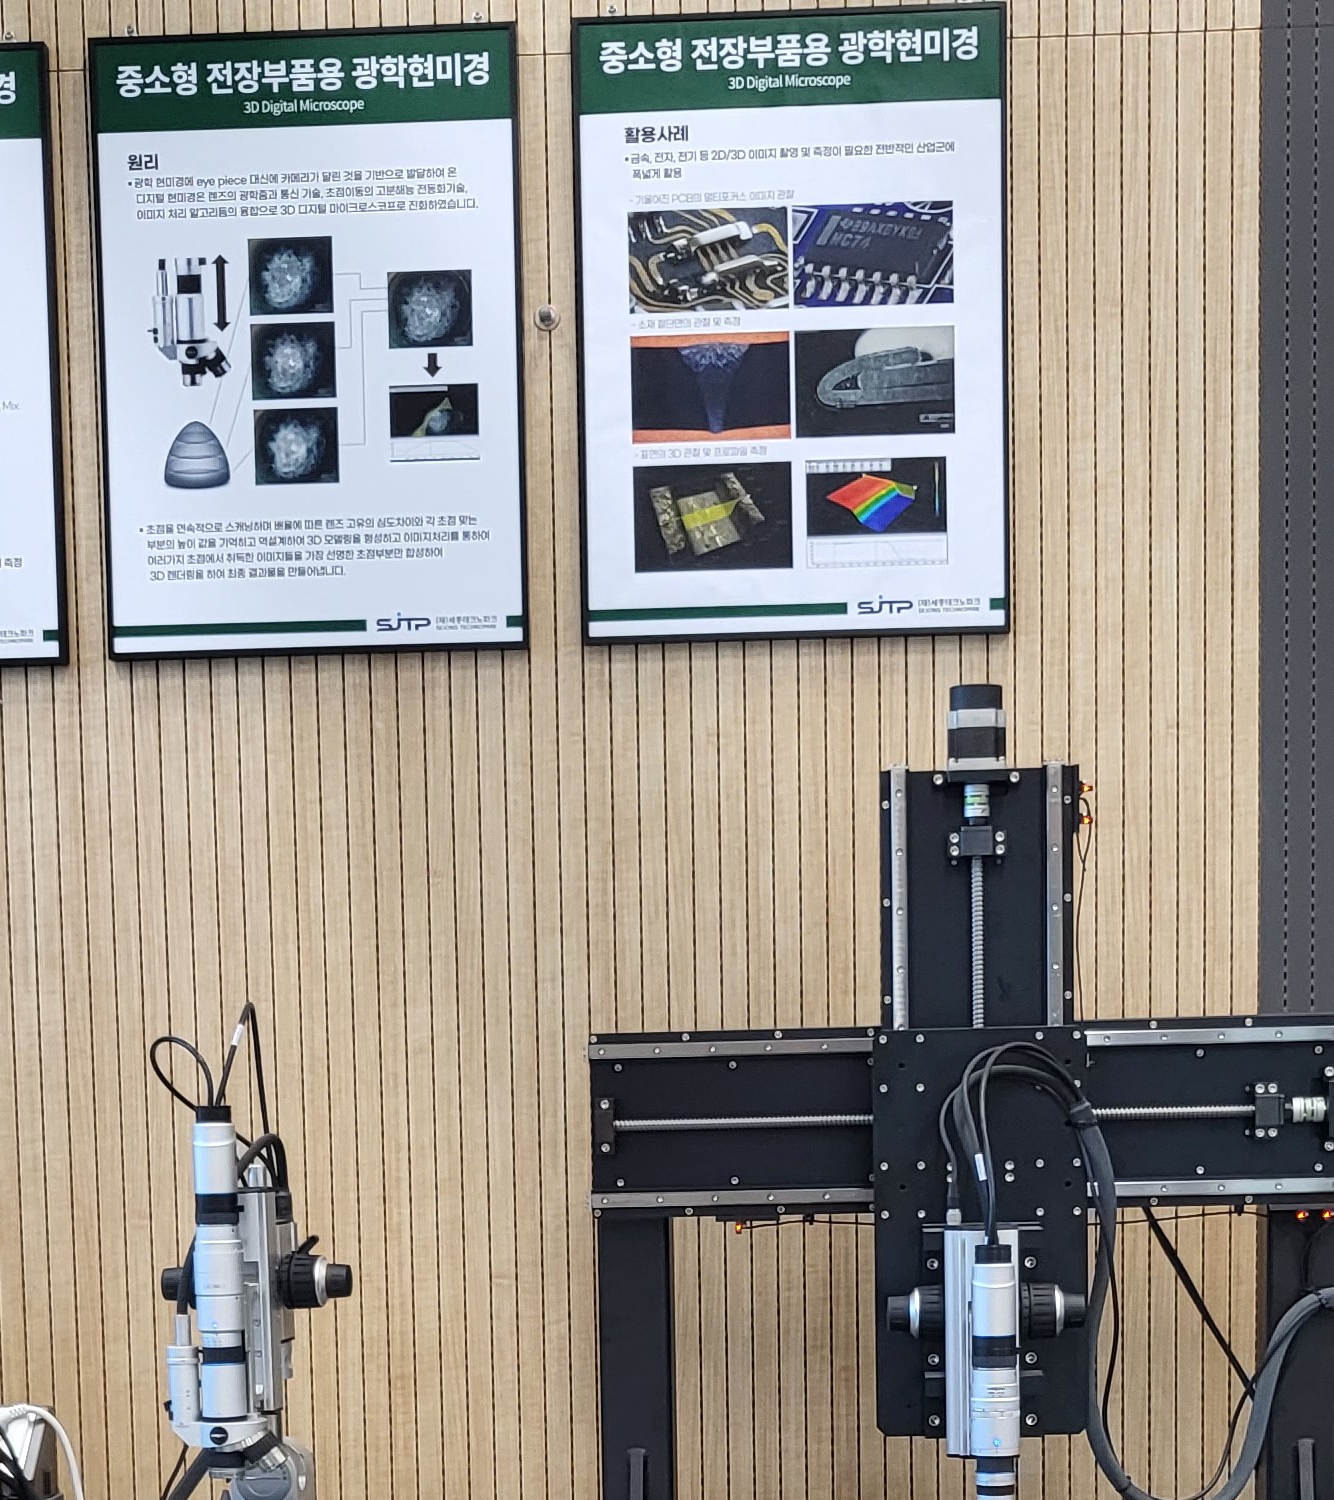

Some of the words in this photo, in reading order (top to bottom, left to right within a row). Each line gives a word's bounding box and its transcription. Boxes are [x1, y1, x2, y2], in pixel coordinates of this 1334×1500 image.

[599, 37, 682, 74] 중소형
[691, 32, 831, 70] 전장부품용
[838, 26, 979, 65] 광학현미경
[116, 63, 198, 98] 중소형
[206, 57, 345, 94] 전장부품용
[351, 52, 490, 89] 광학현미경
[727, 77, 744, 90] 3D
[747, 74, 783, 92] Digital
[785, 73, 851, 89] Microscope
[243, 102, 259, 114] 3D
[262, 99, 297, 116] Digital
[299, 98, 364, 114] Microscope
[625, 125, 688, 143] 활용사례
[127, 154, 158, 171] 원리
[678, 152, 696, 162] 전기
[711, 150, 745, 160] 2D/3D
[749, 148, 776, 159] 이미지
[135, 178, 152, 188] 광학
[156, 177, 194, 188] 현미경에
[197, 178, 215, 188] eye
[218, 176, 247, 188] piece
[250, 174, 278, 184] 대신에
[365, 169, 404, 180] 기반으로
[406, 168, 444, 179] 발달하여
[137, 193, 164, 204] 디지털
[168, 192, 205, 203] 현미경은
[209, 191, 236, 202] 렌즈의
[281, 189, 299, 200] 통신
[326, 186, 373, 197] 초점이동의
[137, 209, 165, 219] 이미지
[168, 208, 186, 218] 처리
[281, 205, 295, 214] 3D
[299, 203, 326, 214] 디지털
[409, 198, 478, 210] 진화하였습니다.
[347, 518, 374, 528] 고유의
[307, 535, 322, 545] 3D
[150, 571, 165, 581] 3D
